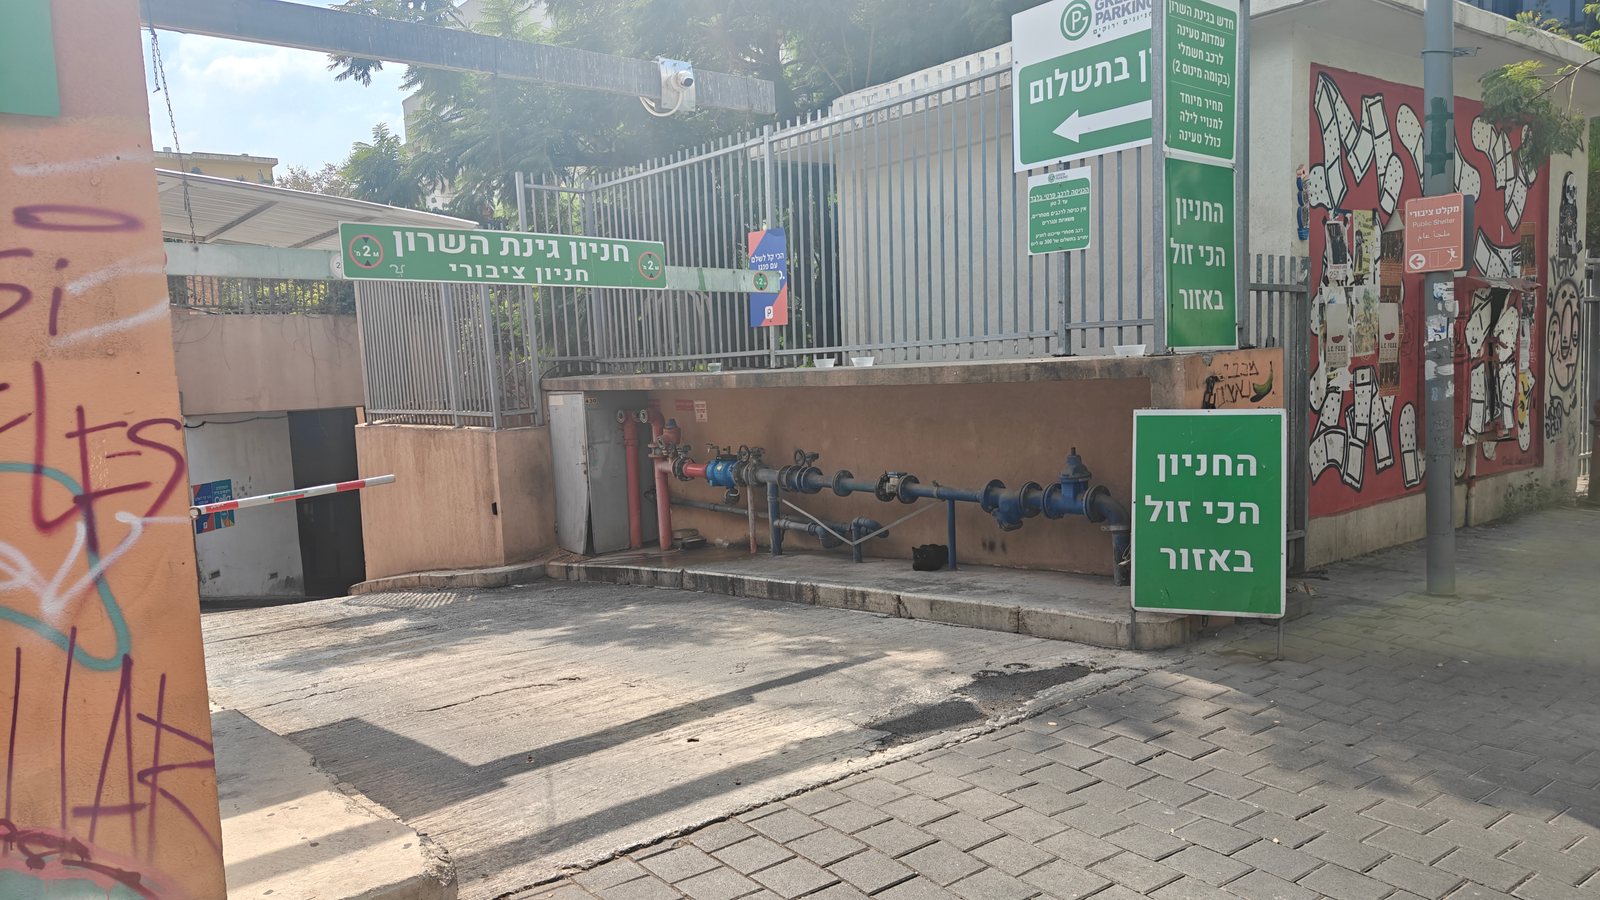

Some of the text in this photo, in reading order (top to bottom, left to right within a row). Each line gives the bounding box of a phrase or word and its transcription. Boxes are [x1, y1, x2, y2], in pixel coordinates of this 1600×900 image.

[1169, 0, 1234, 30] חדש בגינת השרון
[1177, 24, 1225, 47] עמדות טעינה
[1177, 41, 1224, 65] לרכב חשמלי
[1030, 55, 1130, 105] בתשלום
[1182, 63, 1203, 78] מינוס
[1179, 92, 1223, 112] מחיר מיוחד
[1179, 109, 1223, 130] למנויי לילה
[1179, 129, 1221, 148] כולל טעינה
[1175, 197, 1224, 226] החניון
[1409, 205, 1460, 217] מקלט ציבורי
[1412, 218, 1455, 228] Public Shelter
[392, 230, 630, 266] חניון גינת השרון
[1170, 237, 1226, 267] הכי זול
[449, 263, 589, 284] חניון ציבורי
[1179, 288, 1224, 311] באזור
[1157, 453, 1258, 483] החניון
[1144, 495, 1260, 525] הכי זול
[1159, 547, 1254, 573] באזור
